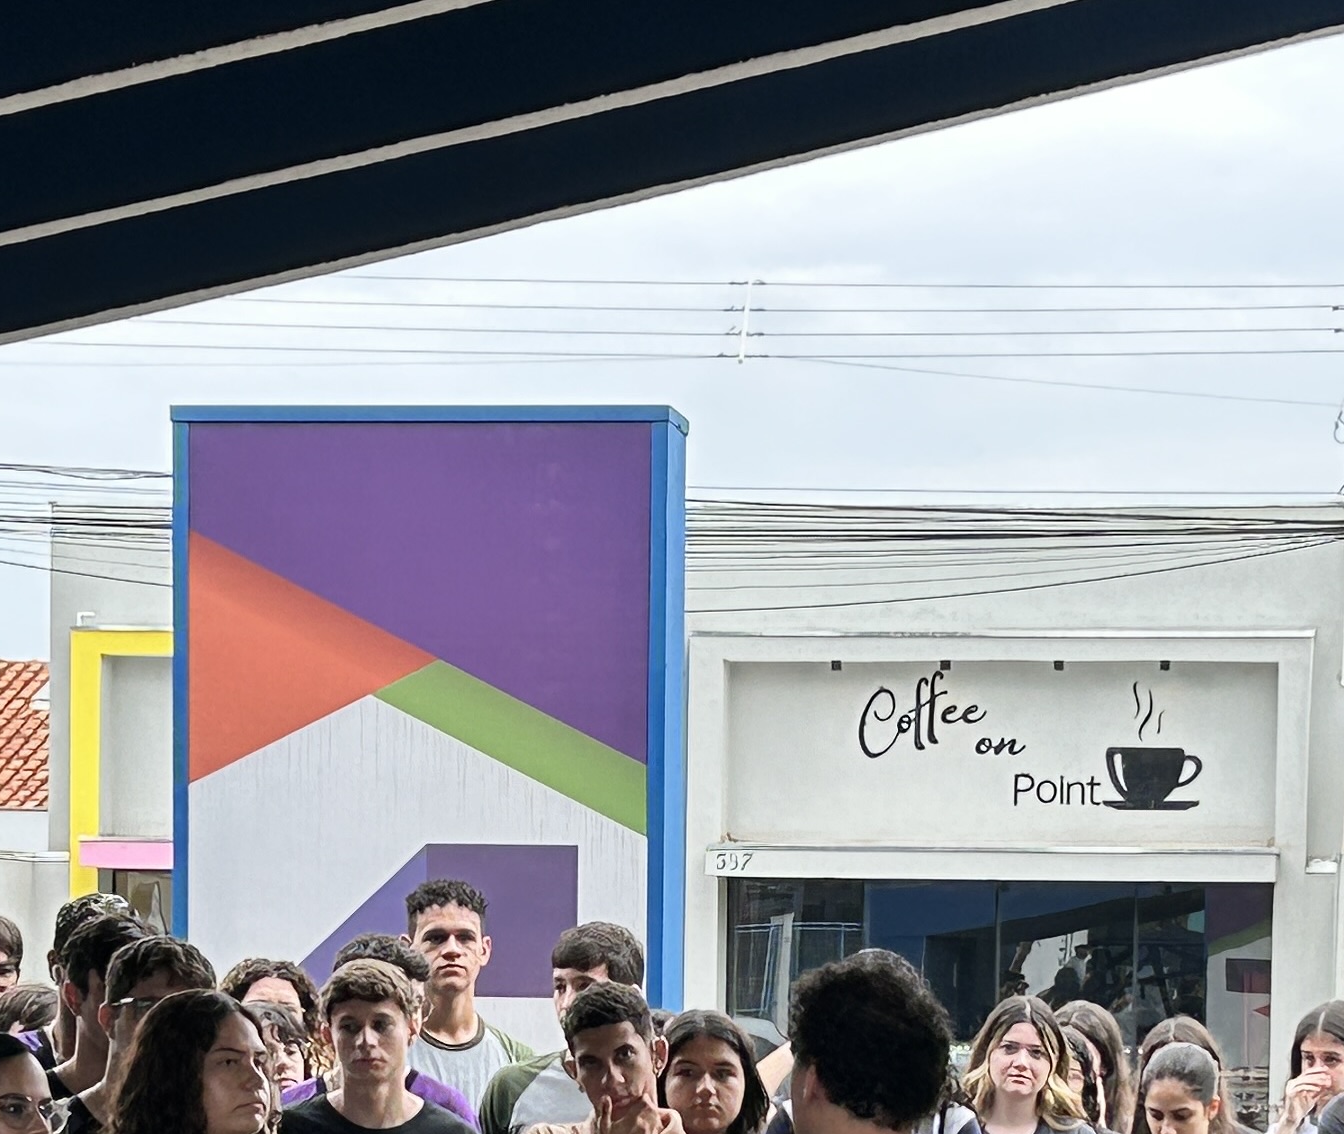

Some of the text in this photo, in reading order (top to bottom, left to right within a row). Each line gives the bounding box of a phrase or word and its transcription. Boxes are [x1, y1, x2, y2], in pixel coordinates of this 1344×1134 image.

[858, 670, 987, 758] Coffee
[975, 736, 1026, 756] on
[1013, 773, 1102, 806] Point
